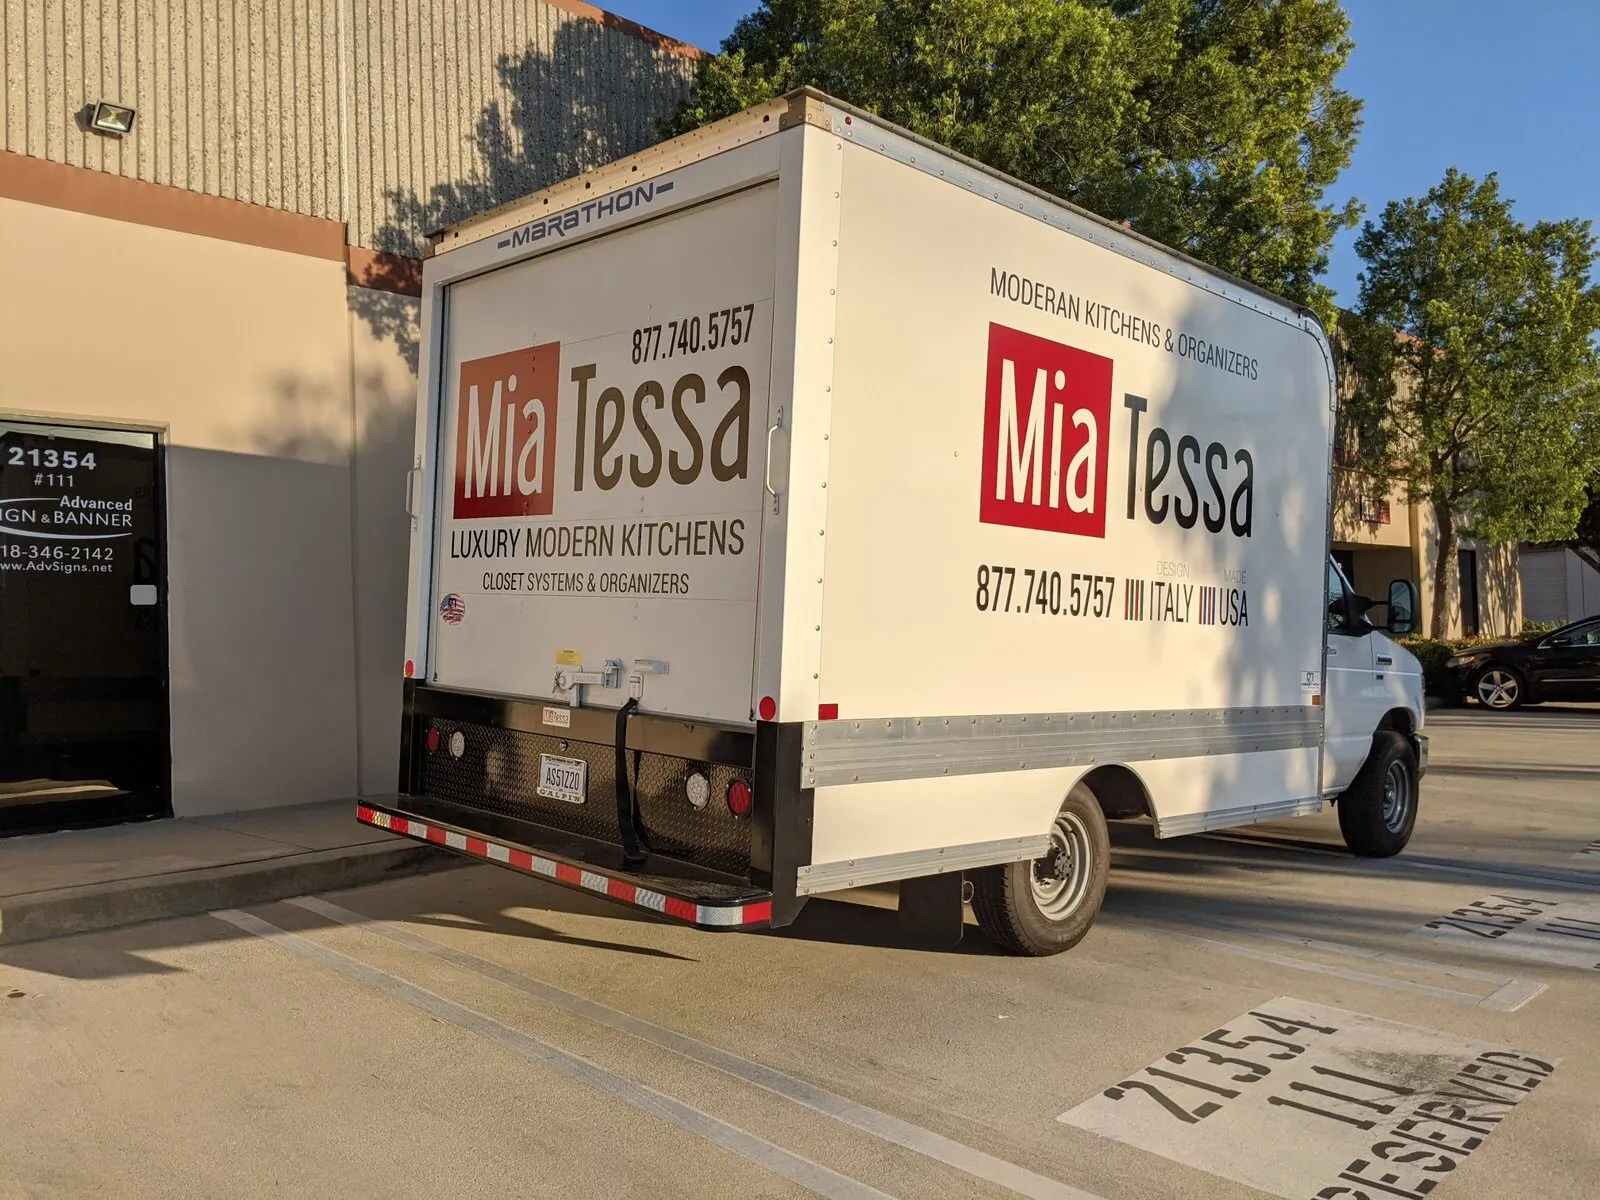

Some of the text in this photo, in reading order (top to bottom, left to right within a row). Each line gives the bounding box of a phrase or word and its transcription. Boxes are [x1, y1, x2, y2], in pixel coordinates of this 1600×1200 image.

[632, 304, 755, 365] 877.740.5757
[990, 267, 1259, 381] MODERAN KITCHENS & ORGANIZERS
[464, 363, 751, 499] Mia Tessa
[995, 358, 1254, 538] Mia Tessa
[8, 447, 97, 470] 21354
[34, 473, 74, 488] #111
[41, 514, 51, 523] &
[54, 511, 133, 527] BANNER
[60, 495, 133, 511] Advanced
[451, 519, 746, 559] LUXURY MODERN KITCHENS
[482, 572, 690, 594] CLOSET SYSTEMS & ORGANIZERS
[1156, 560, 1190, 578] DESIGN
[1223, 569, 1247, 584] MADE
[976, 564, 1115, 618] 877.740.5757
[1149, 581, 1249, 626] ITALY USA
[546, 767, 580, 790] AS51Z20
[1425, 894, 1559, 939] 21354
[1103, 1011, 1338, 1124] 21354
[1267, 1065, 1416, 1131] 111
